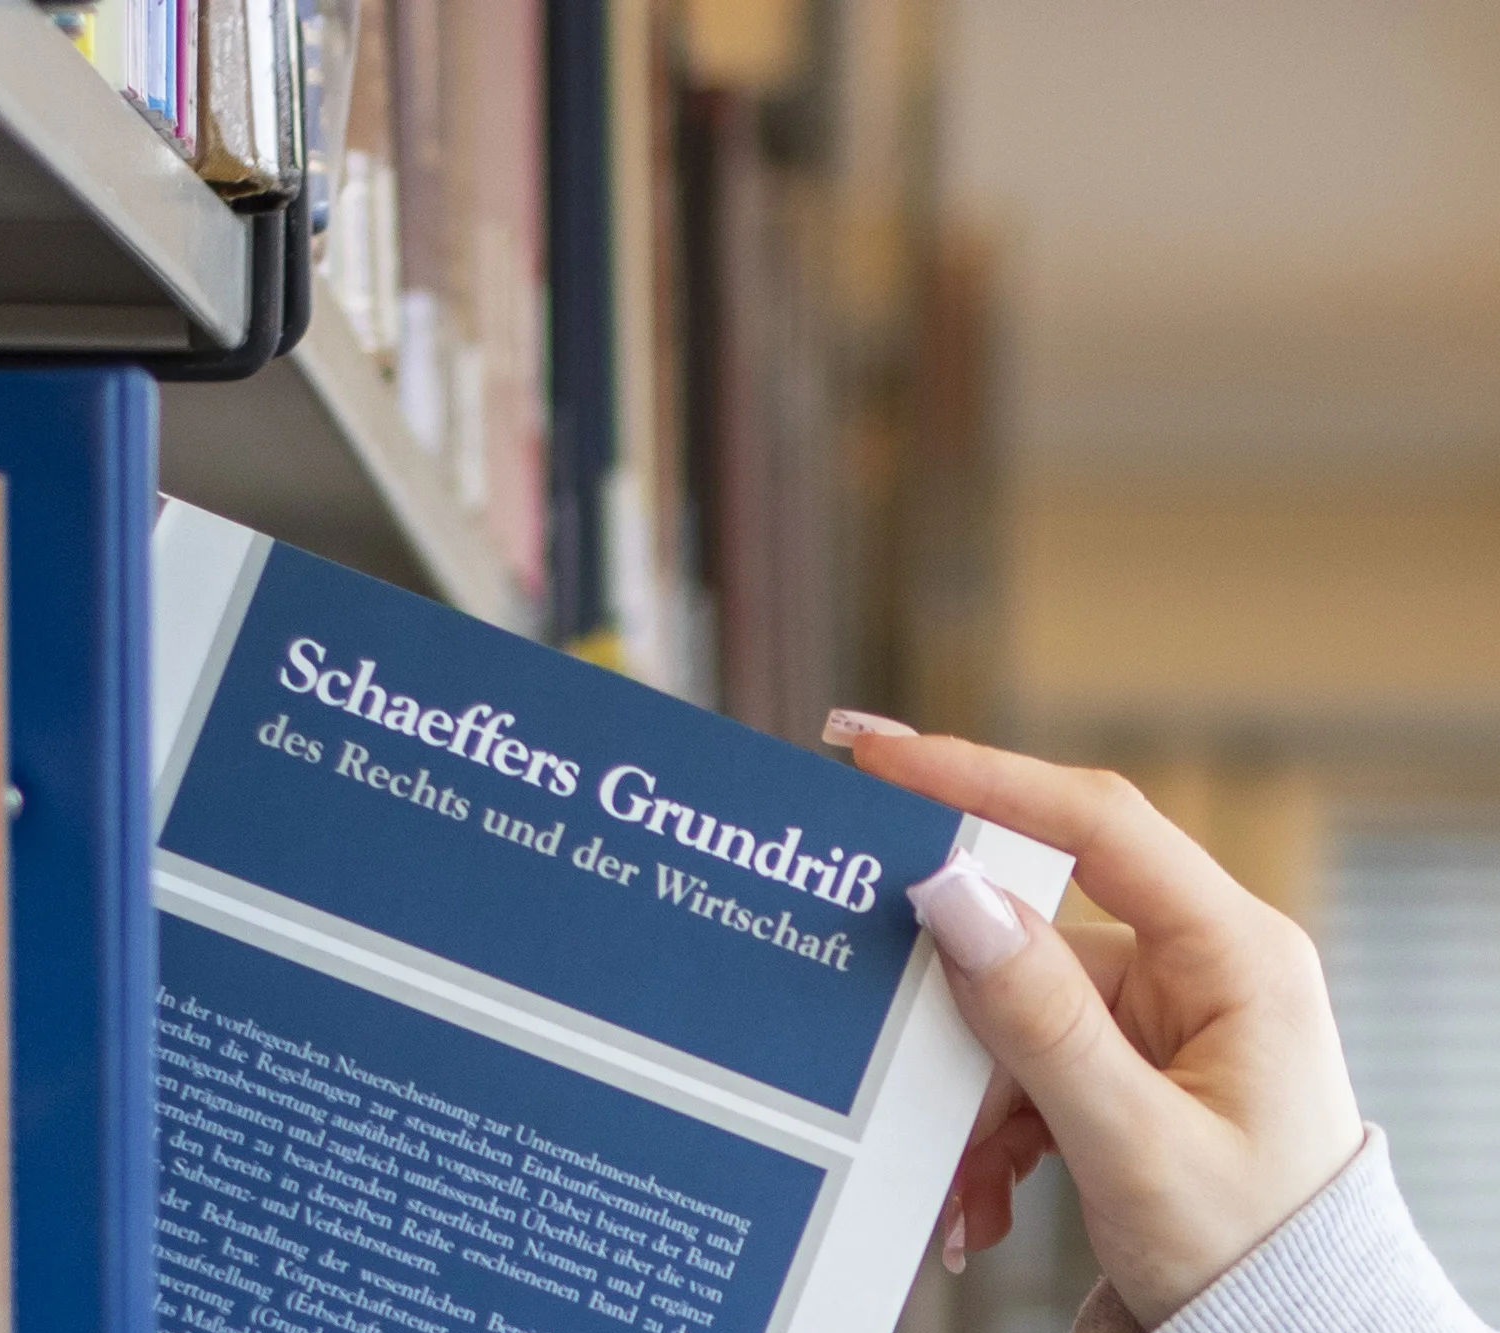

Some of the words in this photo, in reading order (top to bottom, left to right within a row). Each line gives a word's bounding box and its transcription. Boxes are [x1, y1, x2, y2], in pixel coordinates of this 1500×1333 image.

[256, 712, 324, 764] des
[333, 738, 471, 822] Rechts
[481, 806, 566, 858] und
[570, 835, 641, 887] der
[655, 861, 854, 972] Wirtschaft
[278, 636, 581, 798] Schaeffers
[597, 763, 883, 914] Grundriß
[151, 1041, 330, 1126] rmögensbewertung
[329, 1113, 431, 1163] ausführlich
[435, 1152, 532, 1202] vorgestellt.
[536, 1186, 592, 1226] Dabei
[593, 1208, 649, 1247] bietet
[649, 1232, 683, 1260] der
[683, 1244, 736, 1281] Band
[151, 1098, 246, 1147] ernehmen
[251, 1137, 275, 1157] zu
[281, 1142, 398, 1205] beachtenden
[404, 1197, 515, 1251] steuerlichen
[521, 1235, 599, 1283] Normen
[605, 1274, 646, 1300] und
[648, 1292, 716, 1328] ergänzt
[169, 1155, 257, 1203] Substanz-
[259, 1195, 301, 1221] und
[303, 1204, 441, 1277] Verkehrsteuern.
[178, 994, 213, 1022] der
[214, 1012, 331, 1069] vorliegenden
[332, 1052, 481, 1130] Neuerscheinung
[481, 1116, 513, 1139] zur
[514, 1122, 753, 1236] Unternehmensbesteuerung
[178, 1082, 285, 1134] prägnanten
[286, 1123, 328, 1149] und
[324, 1138, 400, 1179] zugleich
[401, 1168, 517, 1224] umfassenden
[519, 1206, 610, 1260] Überblick
[611, 1246, 655, 1277] über
[654, 1262, 686, 1289] die
[688, 1278, 724, 1305] von
[217, 1037, 250, 1064] die
[254, 1049, 362, 1109] Regelungen
[367, 1099, 399, 1122] zur
[402, 1114, 514, 1168] steuerlichen
[519, 1152, 700, 1243] Einkunftsermittlung
[704, 1231, 745, 1257] und
[151, 1270, 236, 1316] wertung
[157, 1185, 192, 1213] der
[199, 1199, 311, 1262] Behandlung
[316, 1247, 351, 1274] der
[359, 1267, 477, 1324] wesentlichen
[167, 1128, 205, 1158] den
[210, 1142, 273, 1183] bereits
[278, 1175, 301, 1195] in
[305, 1181, 393, 1231] derselben
[398, 1215, 456, 1254] Reihe
[460, 1247, 581, 1304] erschienenen
[586, 1288, 639, 1325] Band
[220, 1234, 260, 1268] bzw.
